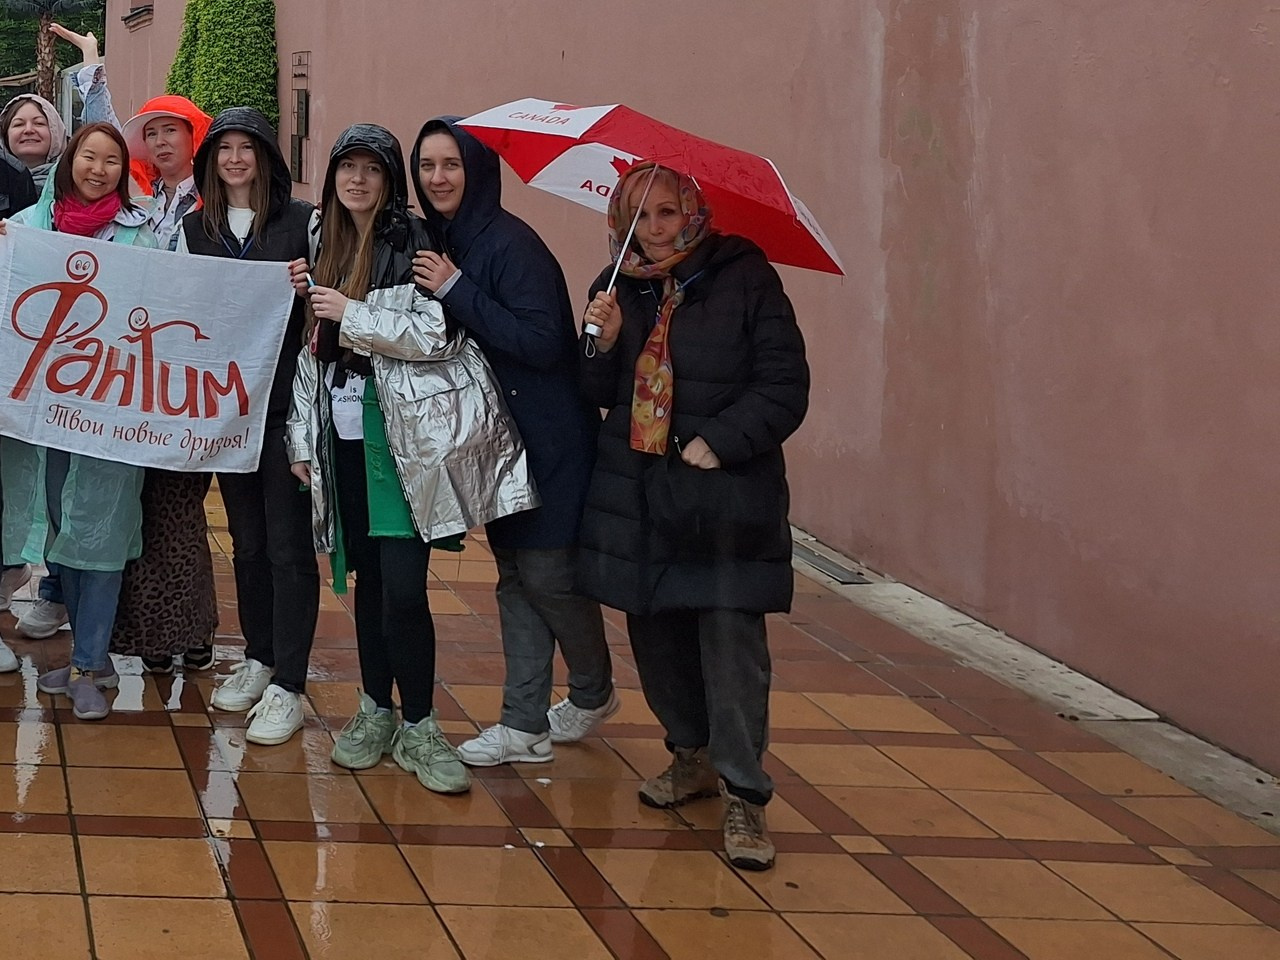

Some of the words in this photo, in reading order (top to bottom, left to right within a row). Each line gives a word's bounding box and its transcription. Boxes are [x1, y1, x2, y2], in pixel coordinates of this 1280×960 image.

[508, 111, 571, 125] CANADA
[45, 403, 105, 436] Твои
[112, 420, 173, 446] новые
[179, 427, 250, 462] друзья!
